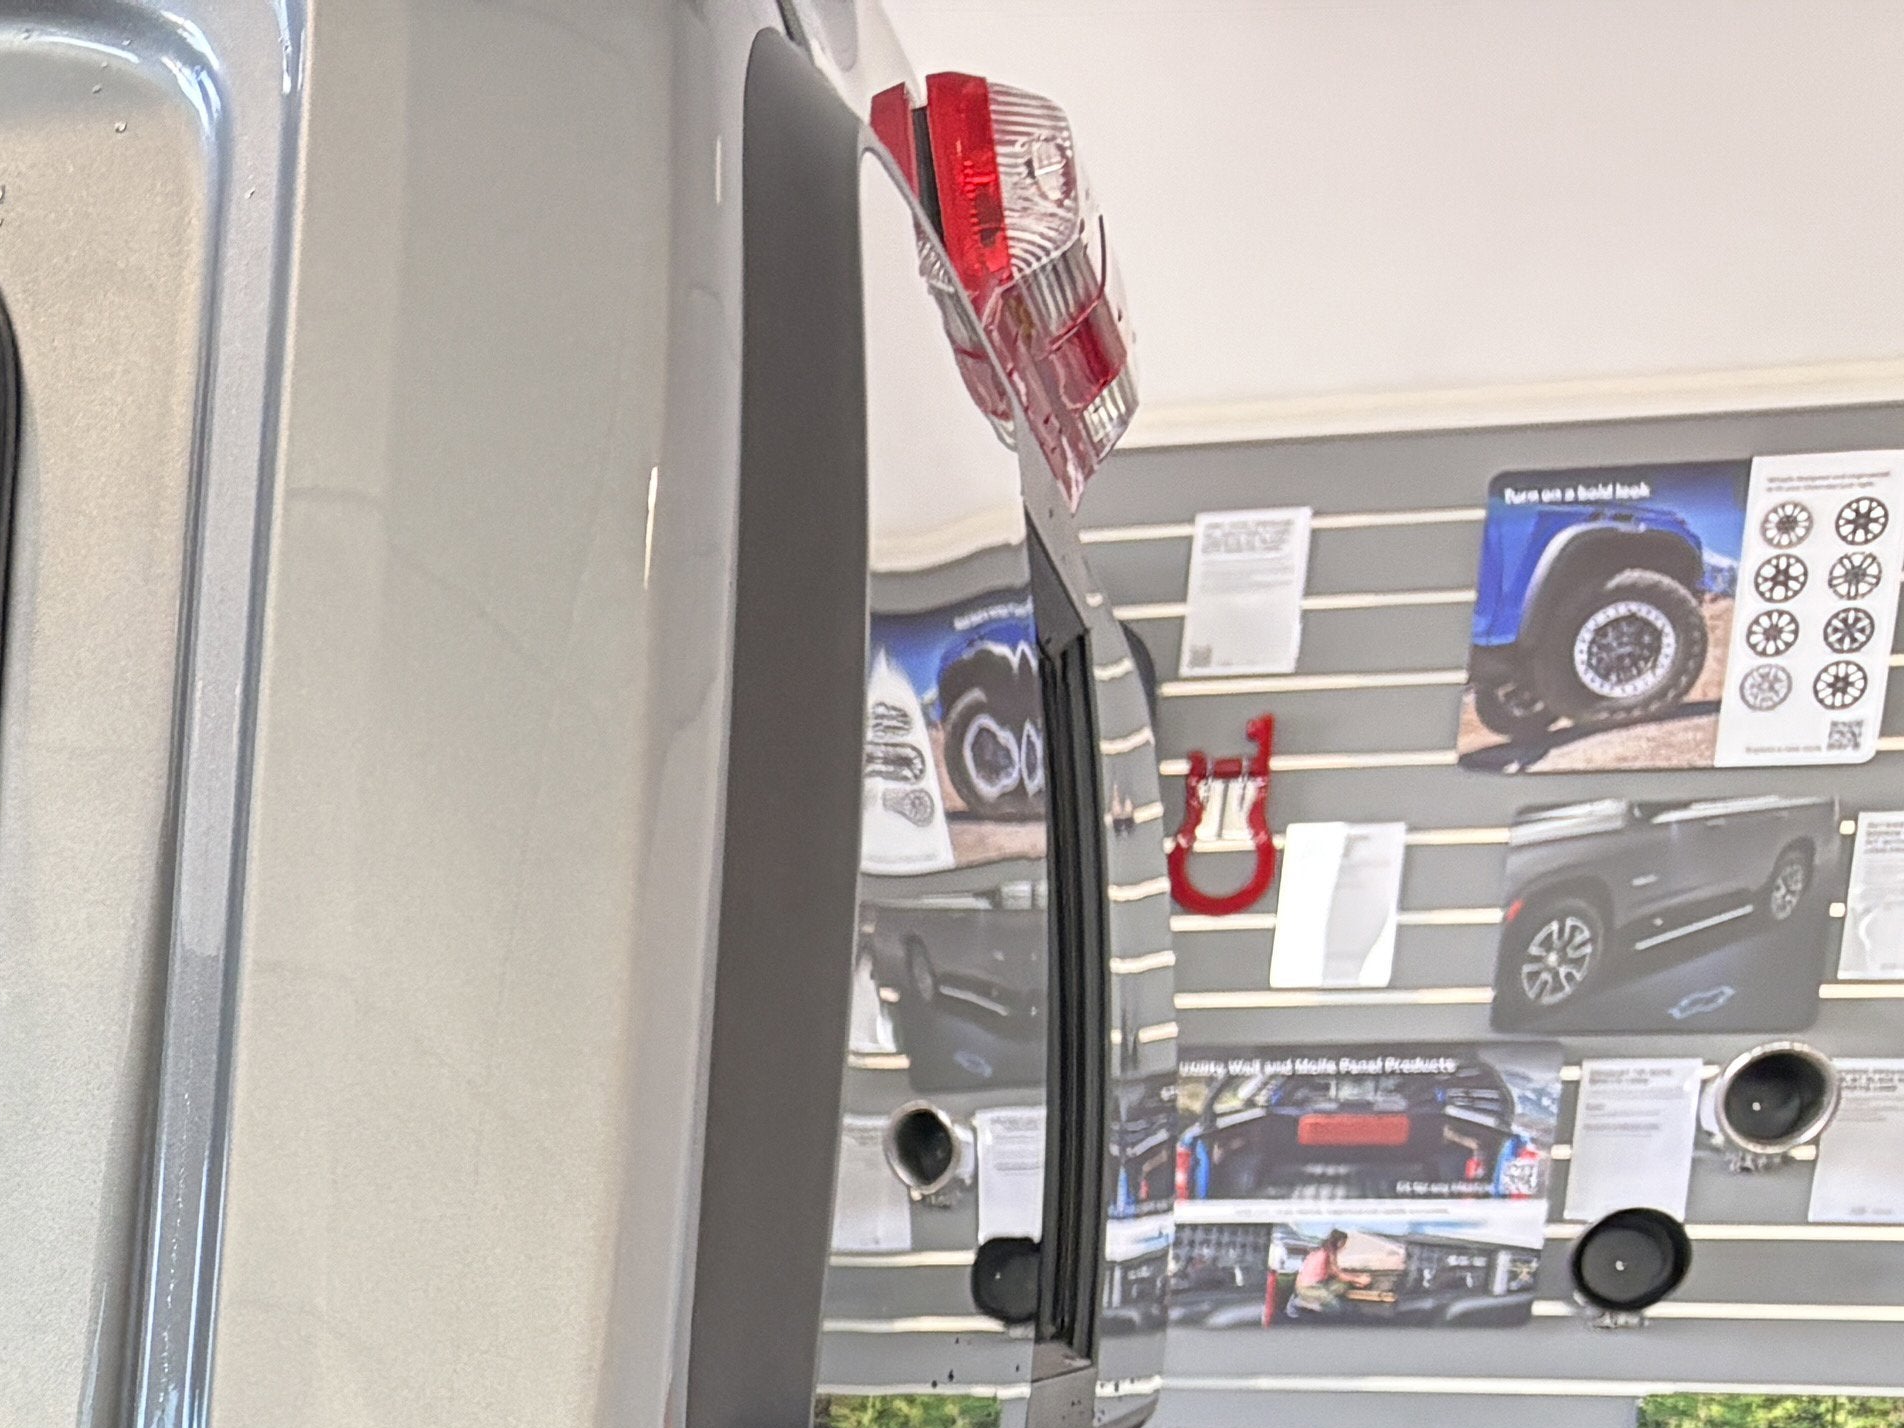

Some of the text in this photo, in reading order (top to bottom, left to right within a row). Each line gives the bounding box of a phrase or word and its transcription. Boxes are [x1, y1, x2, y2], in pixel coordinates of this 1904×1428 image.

[1504, 487, 1539, 505] Turn
[1542, 488, 1562, 502] on
[1577, 482, 1613, 501] bold
[1615, 481, 1650, 500] look
[1385, 1056, 1457, 1074] Products
